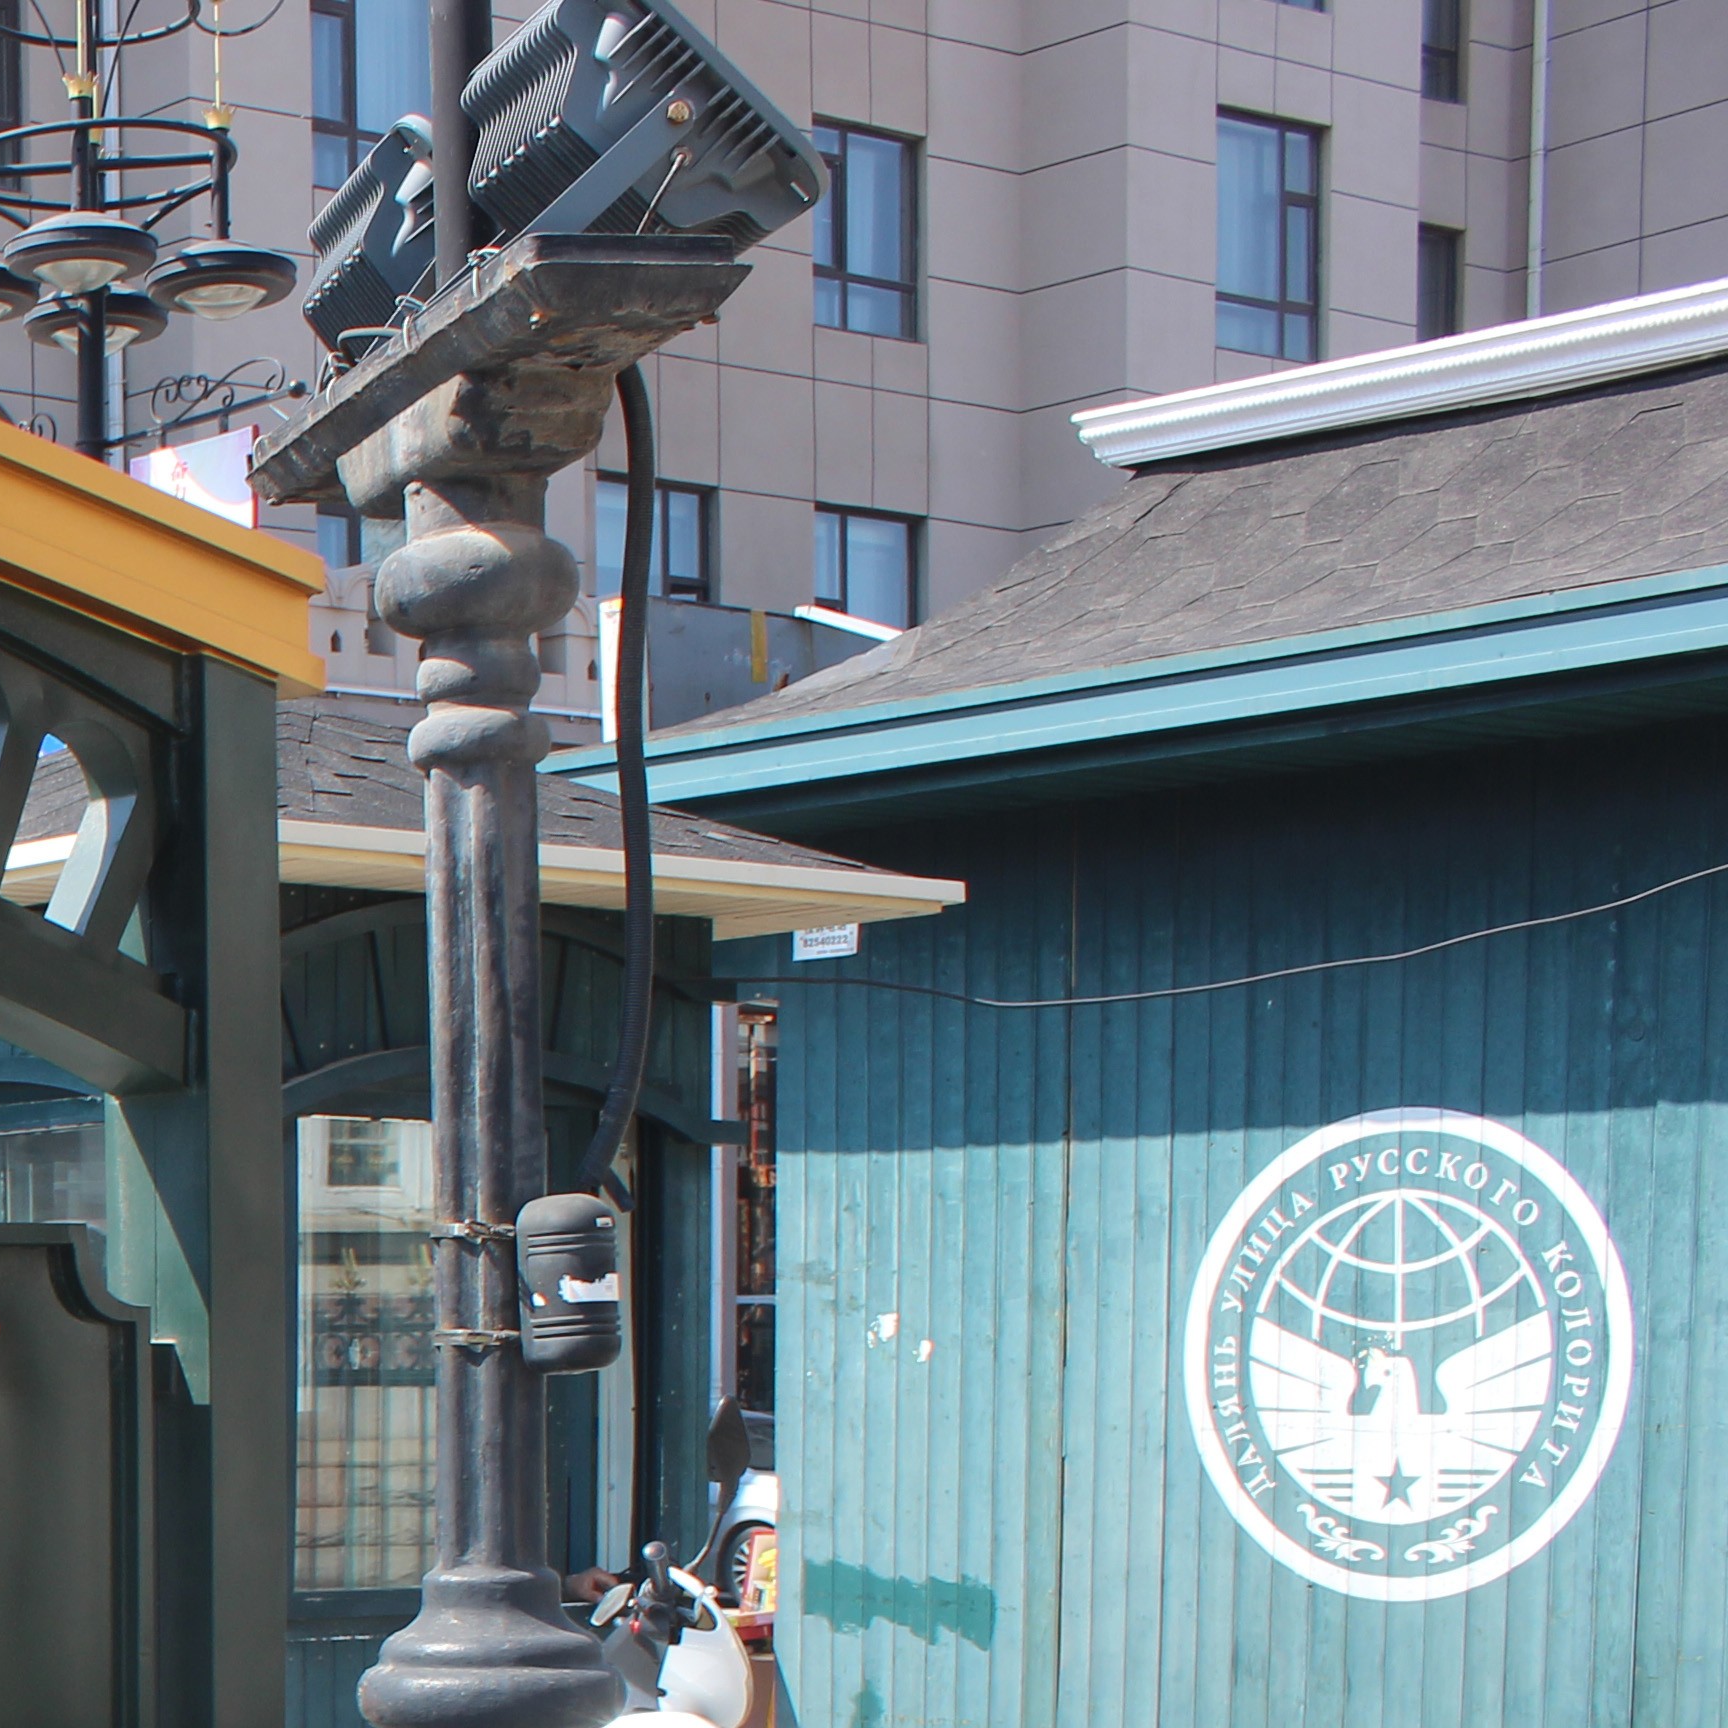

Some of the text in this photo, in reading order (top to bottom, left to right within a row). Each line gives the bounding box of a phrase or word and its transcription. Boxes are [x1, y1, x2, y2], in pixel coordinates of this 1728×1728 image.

[1213, 1147, 1593, 1499] ДАЛЯНЬ УЛИЦА РУССКОГО КОЛОРИТА
